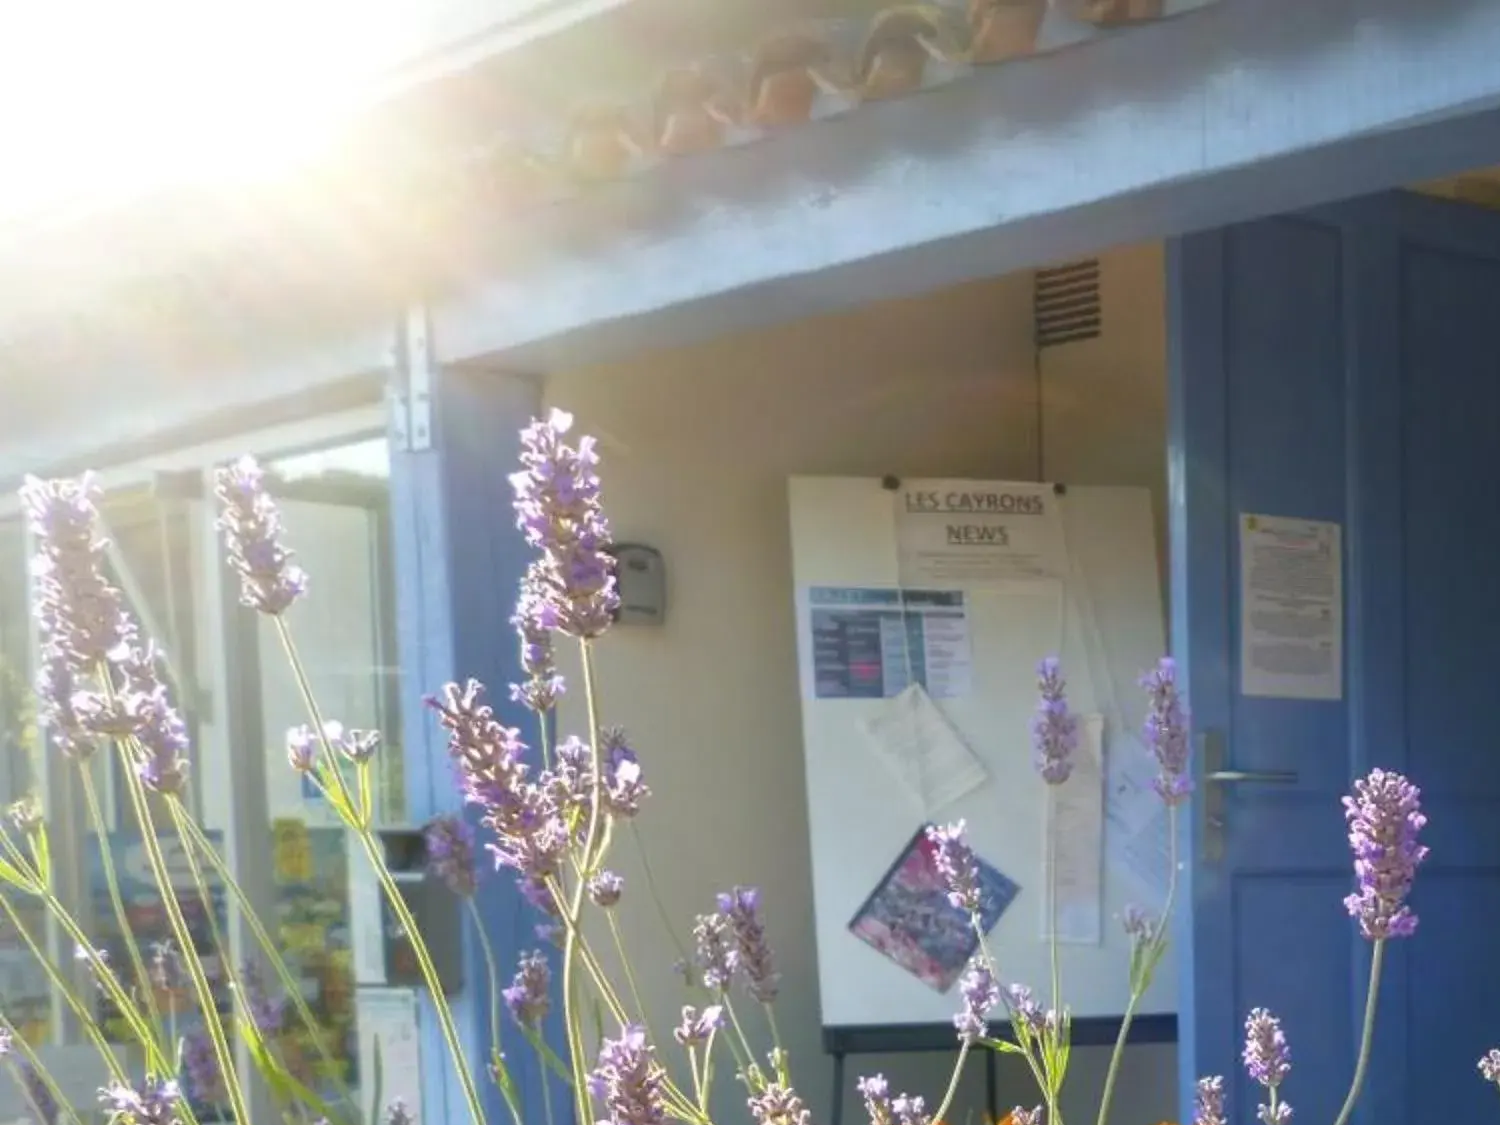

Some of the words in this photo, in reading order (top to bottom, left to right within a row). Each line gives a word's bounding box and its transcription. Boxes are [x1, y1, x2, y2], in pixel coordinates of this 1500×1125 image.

[905, 491, 940, 511] LES
[946, 492, 1044, 513] CAYRONS
[946, 524, 1010, 543] NEWS
